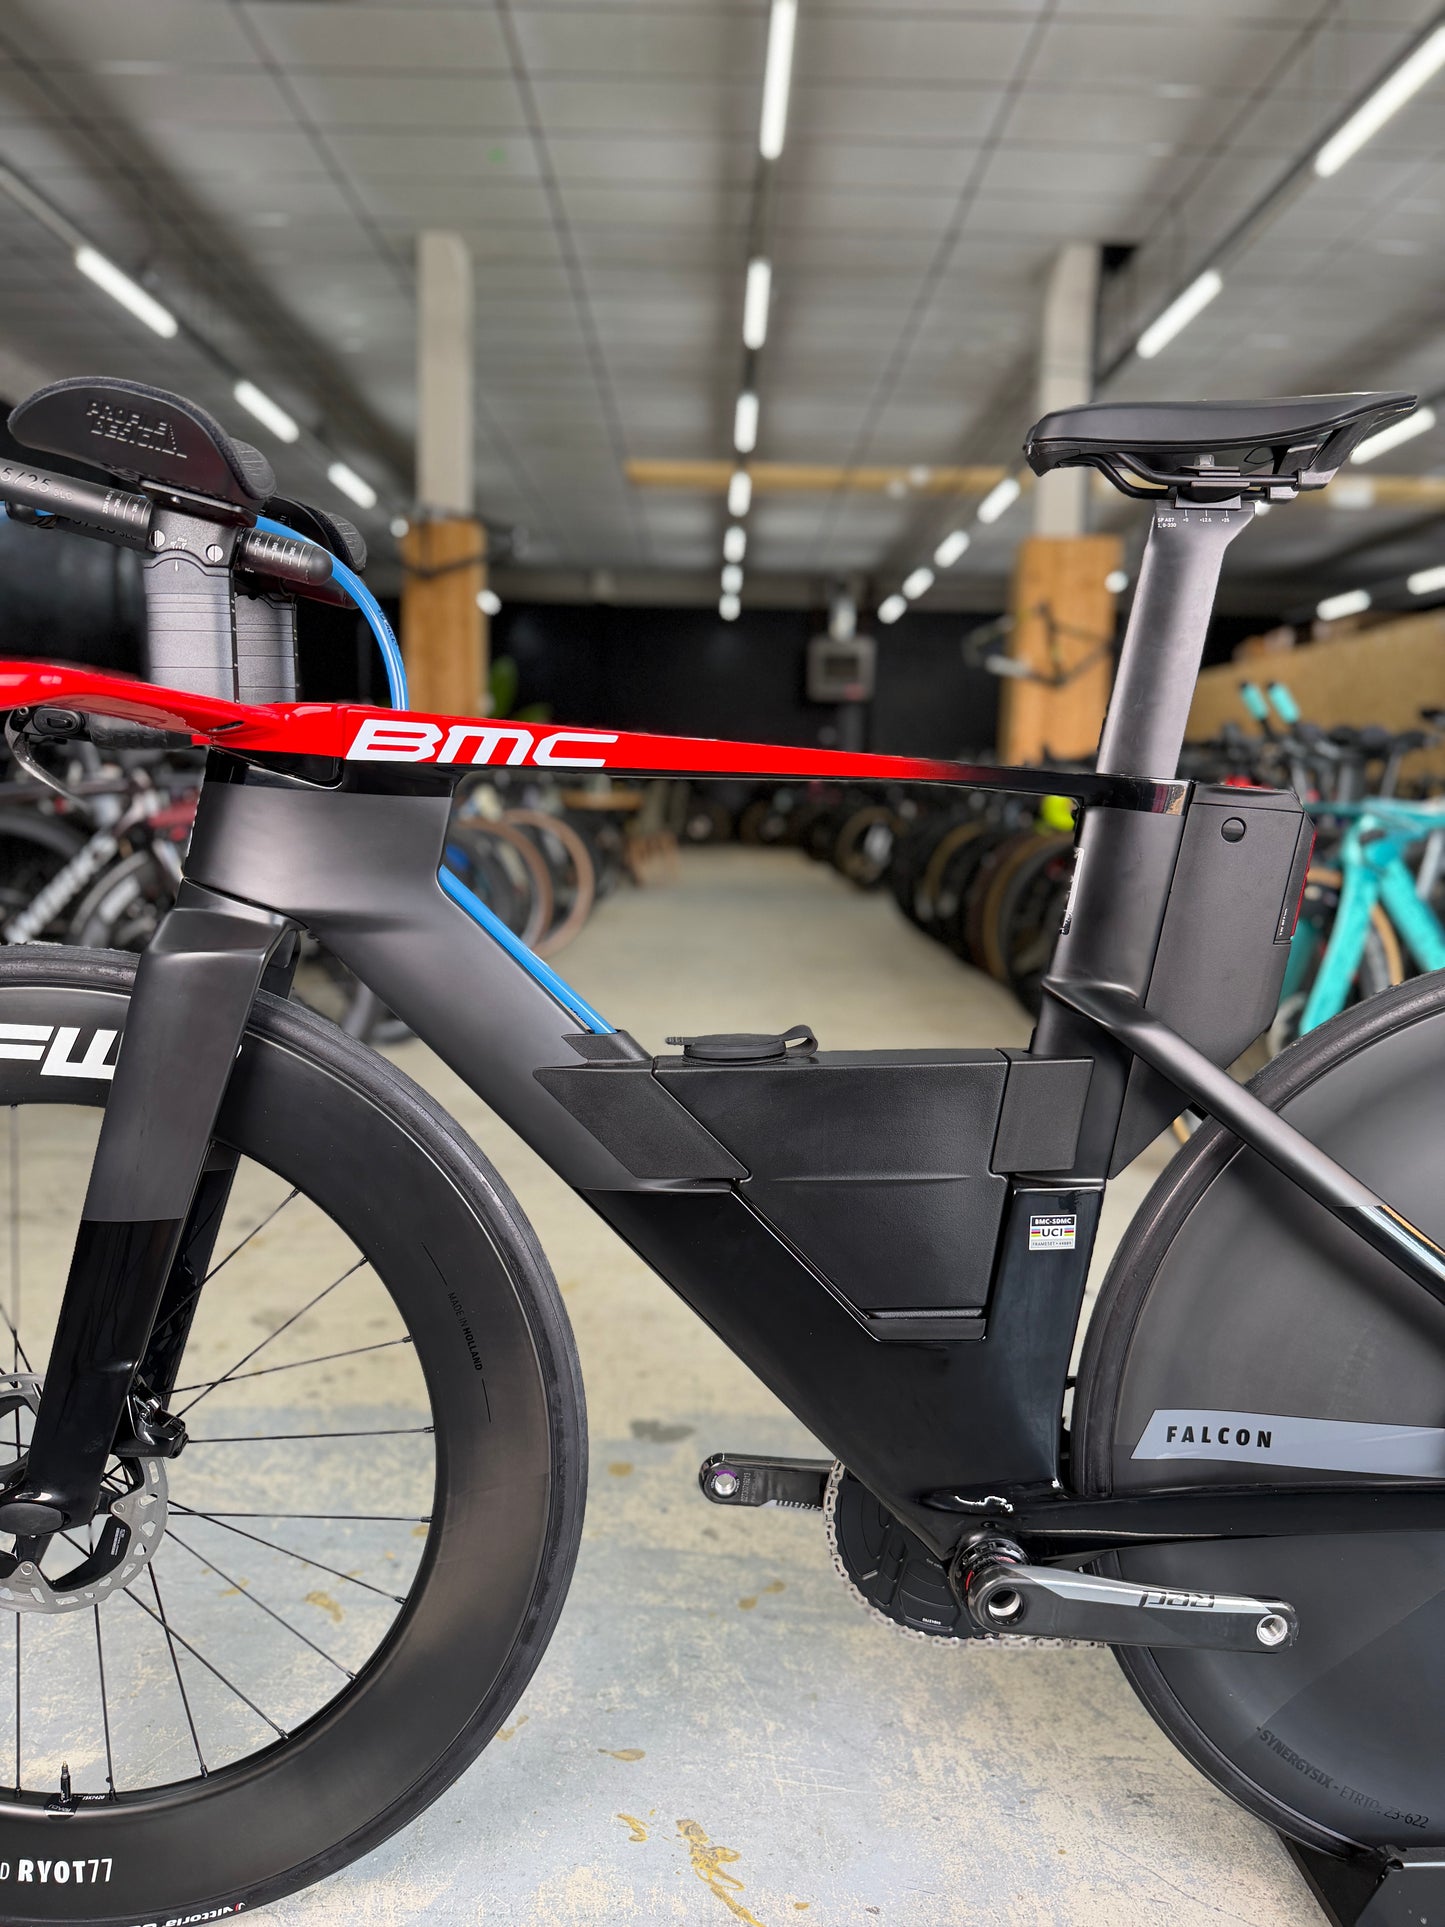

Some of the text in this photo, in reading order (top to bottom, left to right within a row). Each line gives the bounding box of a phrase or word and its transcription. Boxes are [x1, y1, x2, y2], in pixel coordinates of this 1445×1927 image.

[346, 719, 618, 767] BMC
[1042, 1228, 1063, 1237] UCI
[447, 1291, 483, 1371] MADE IN HOLLAND
[1166, 1425, 1272, 1448] FALCON
[1259, 1729, 1334, 1790] SYNERGYSIX
[1384, 1805, 1429, 1829] 23-622
[18, 1857, 113, 1884] RYOT77
